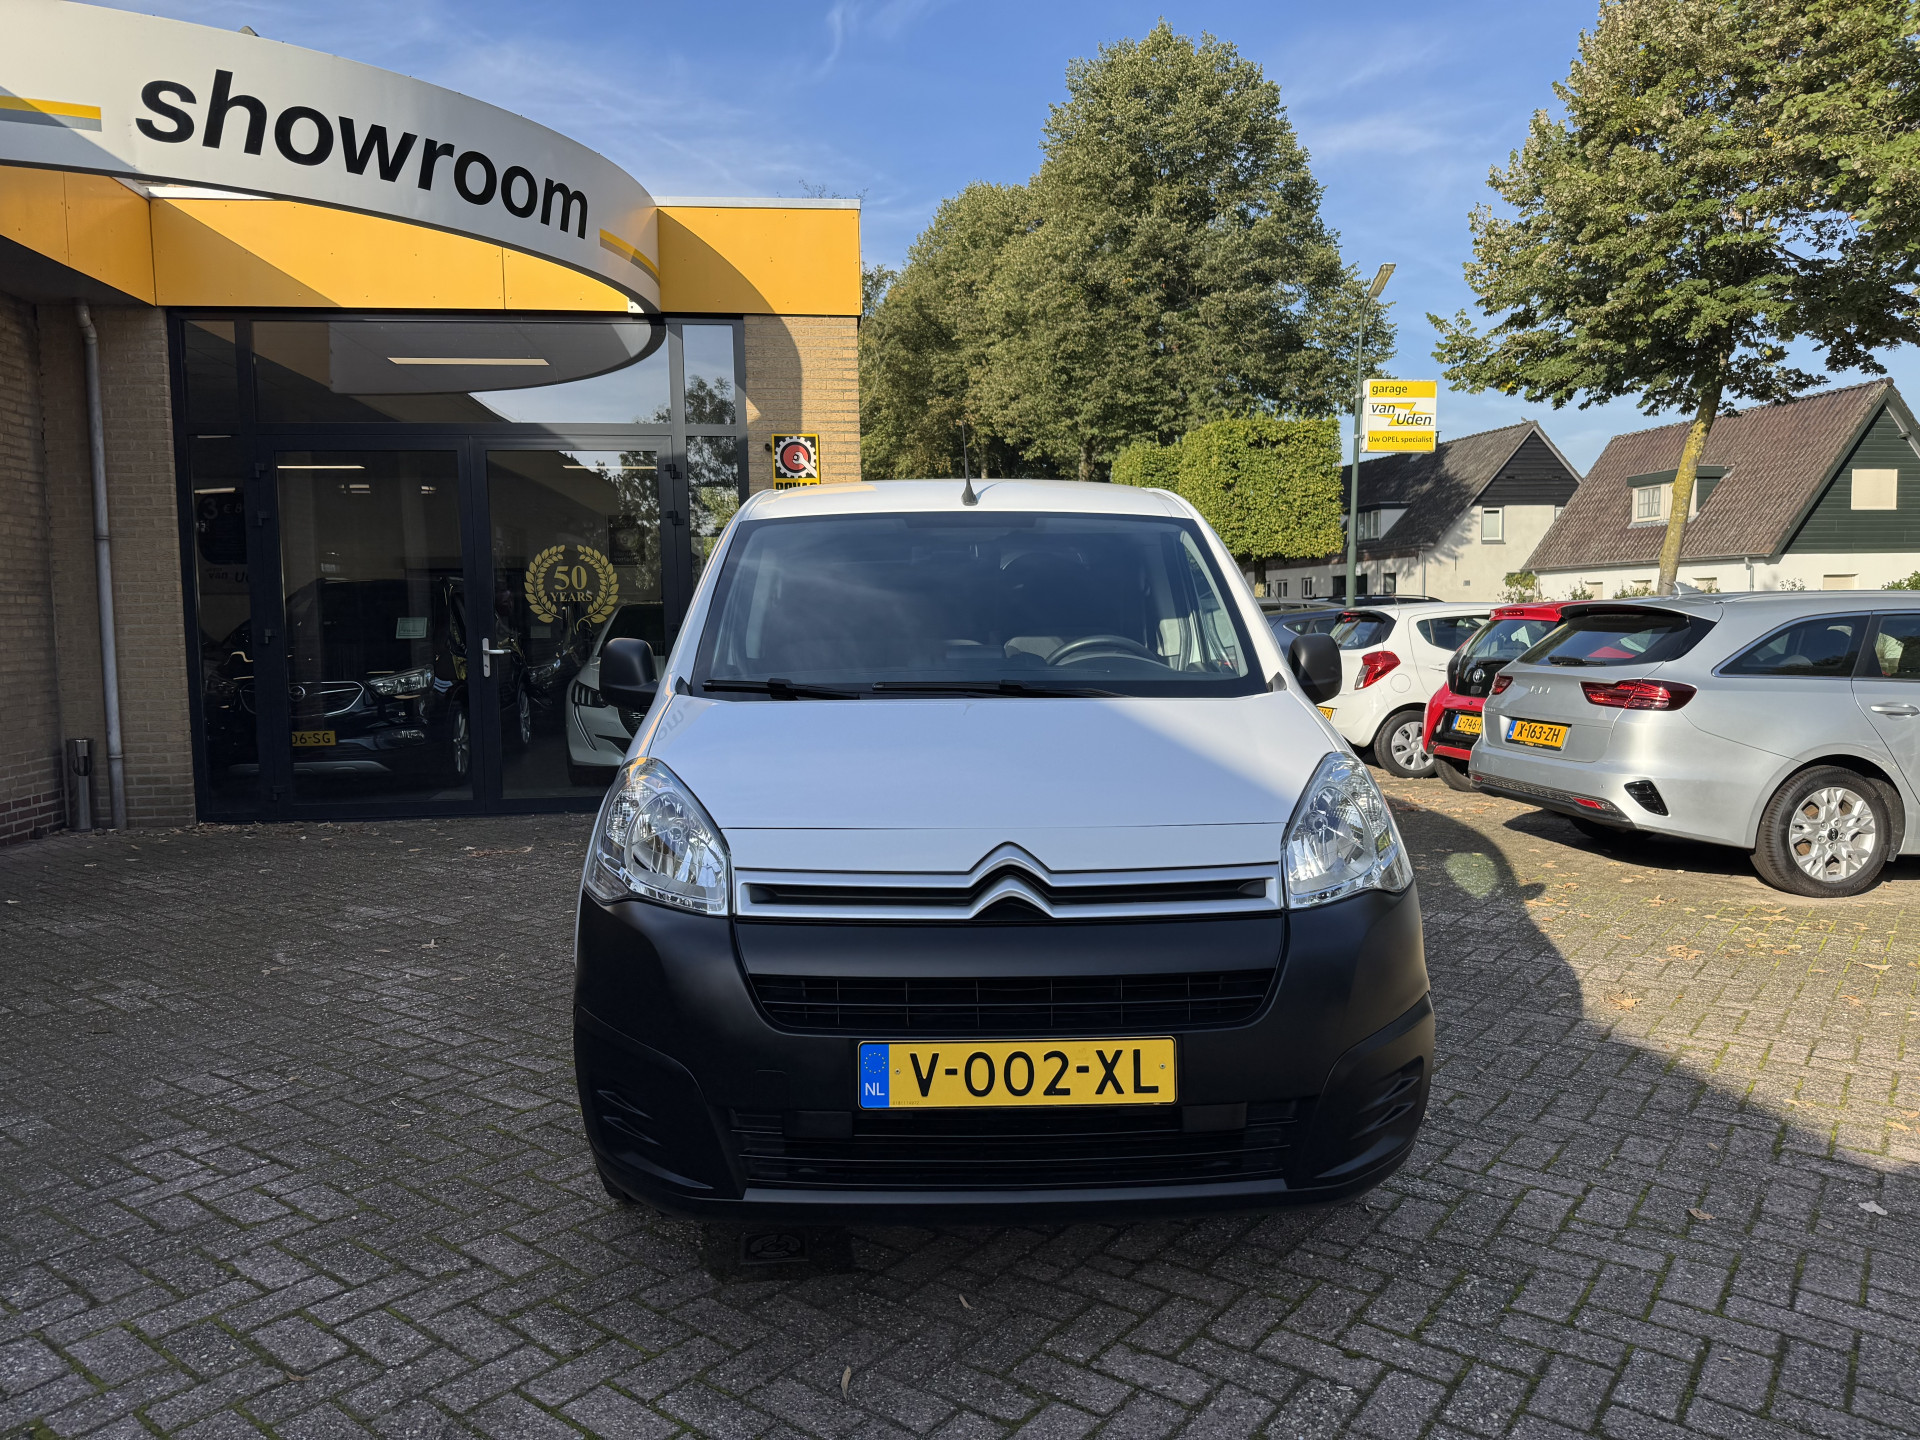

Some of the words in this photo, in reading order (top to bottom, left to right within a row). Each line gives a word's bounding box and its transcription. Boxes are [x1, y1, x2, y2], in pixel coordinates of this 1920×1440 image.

[135, 69, 589, 239] showroom
[1372, 385, 1408, 395] garage
[1371, 404, 1396, 413] van
[1396, 413, 1432, 425] Uden
[1400, 436, 1432, 444] specialist
[554, 566, 587, 590] 50
[550, 592, 593, 602] YEARS
[1517, 723, 1561, 743] X-163-ZH
[864, 1082, 885, 1096] NL
[909, 1048, 1159, 1097] V-002-XL
